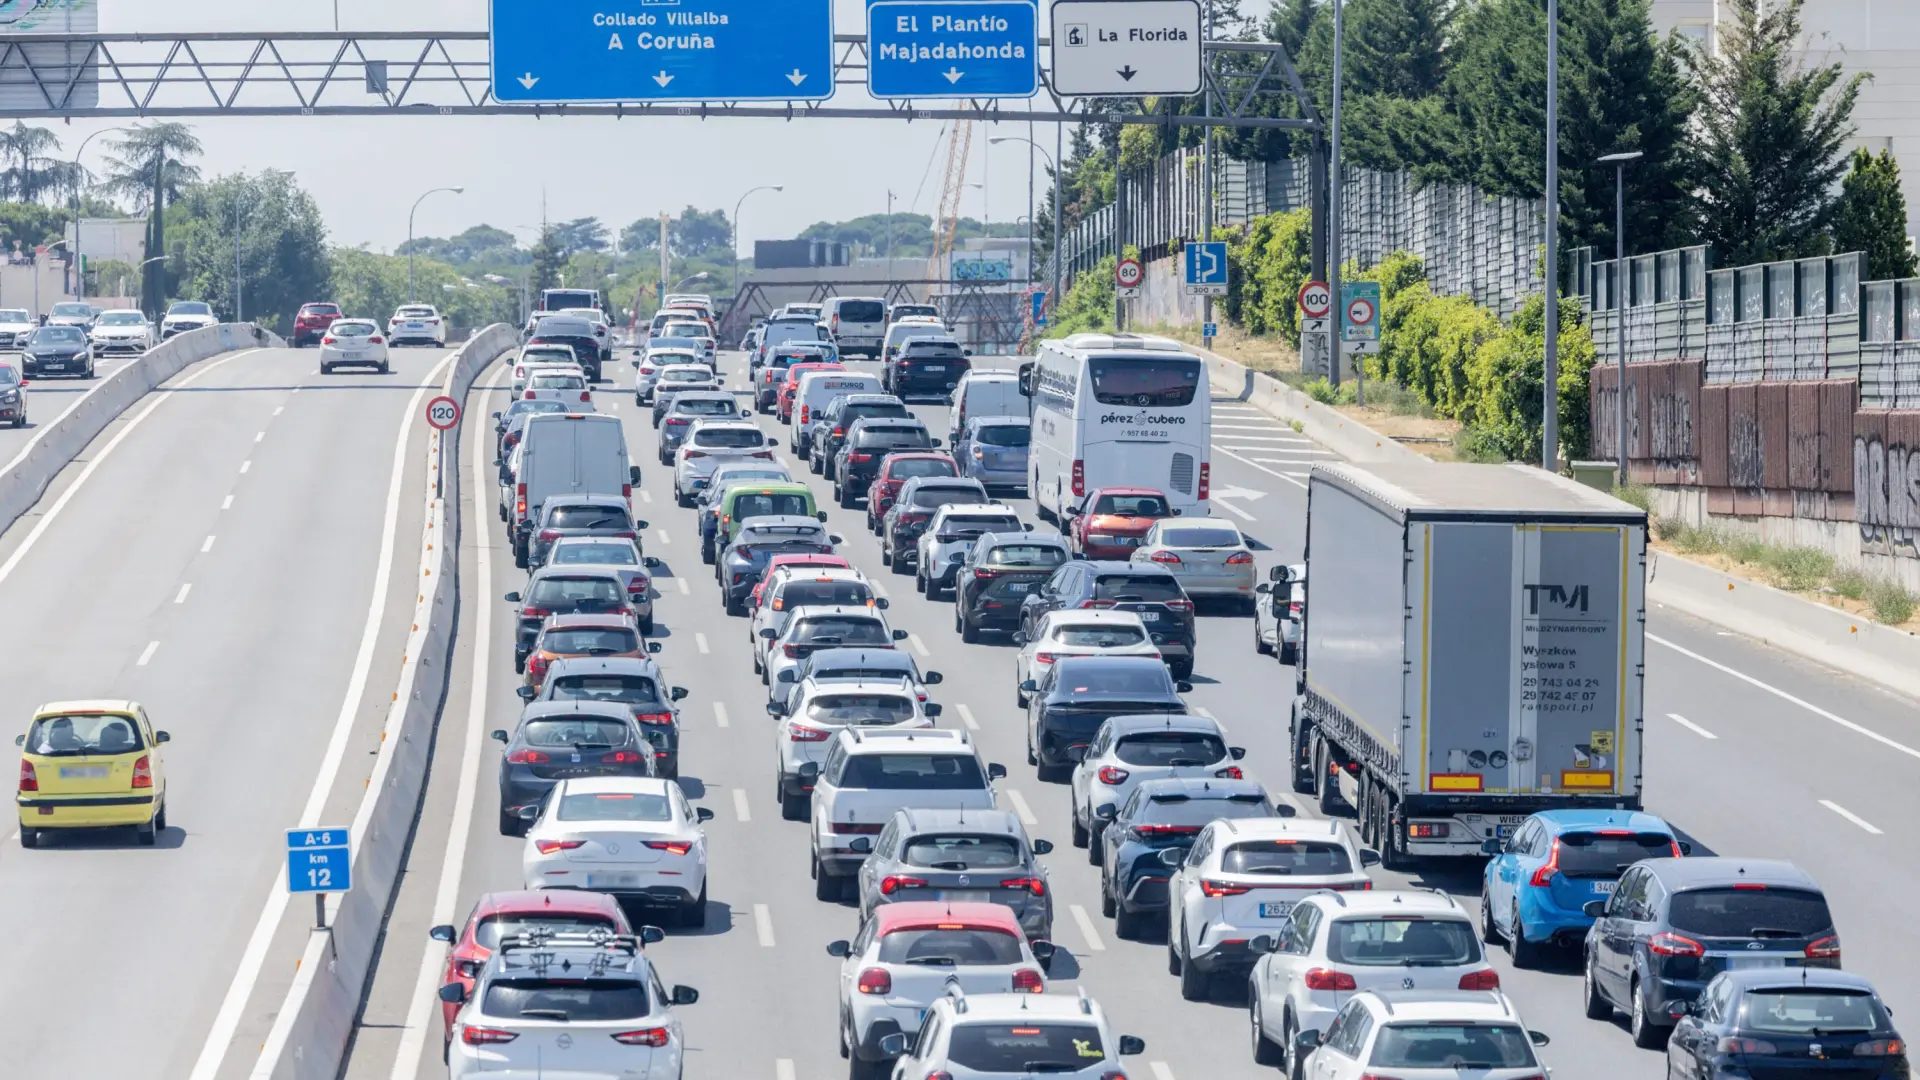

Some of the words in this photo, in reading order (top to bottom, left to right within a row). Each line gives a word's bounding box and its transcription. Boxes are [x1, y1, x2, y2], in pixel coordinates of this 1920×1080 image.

[593, 13, 656, 26] Collado
[666, 12, 729, 26] Villalba
[896, 15, 919, 33] El
[931, 14, 1008, 32] Plantío
[608, 33, 624, 50] A
[637, 32, 715, 50] Coruña
[1098, 28, 1118, 42] La
[1129, 27, 1188, 41] Florida
[879, 42, 1026, 63] Majadahonda
[1121, 268, 1137, 277] 80
[1193, 286, 1209, 294] 300
[1305, 294, 1329, 305] 100
[431, 407, 455, 419] 120
[1100, 411, 1134, 425] pérez
[1147, 414, 1186, 425] cubero
[1522, 678, 1537, 687] 29
[1522, 691, 1537, 701] 29
[1540, 691, 1562, 701] 742
[1582, 692, 1596, 702] 07
[304, 831, 332, 846] A-6
[309, 853, 328, 865] km
[307, 868, 332, 887] 12
